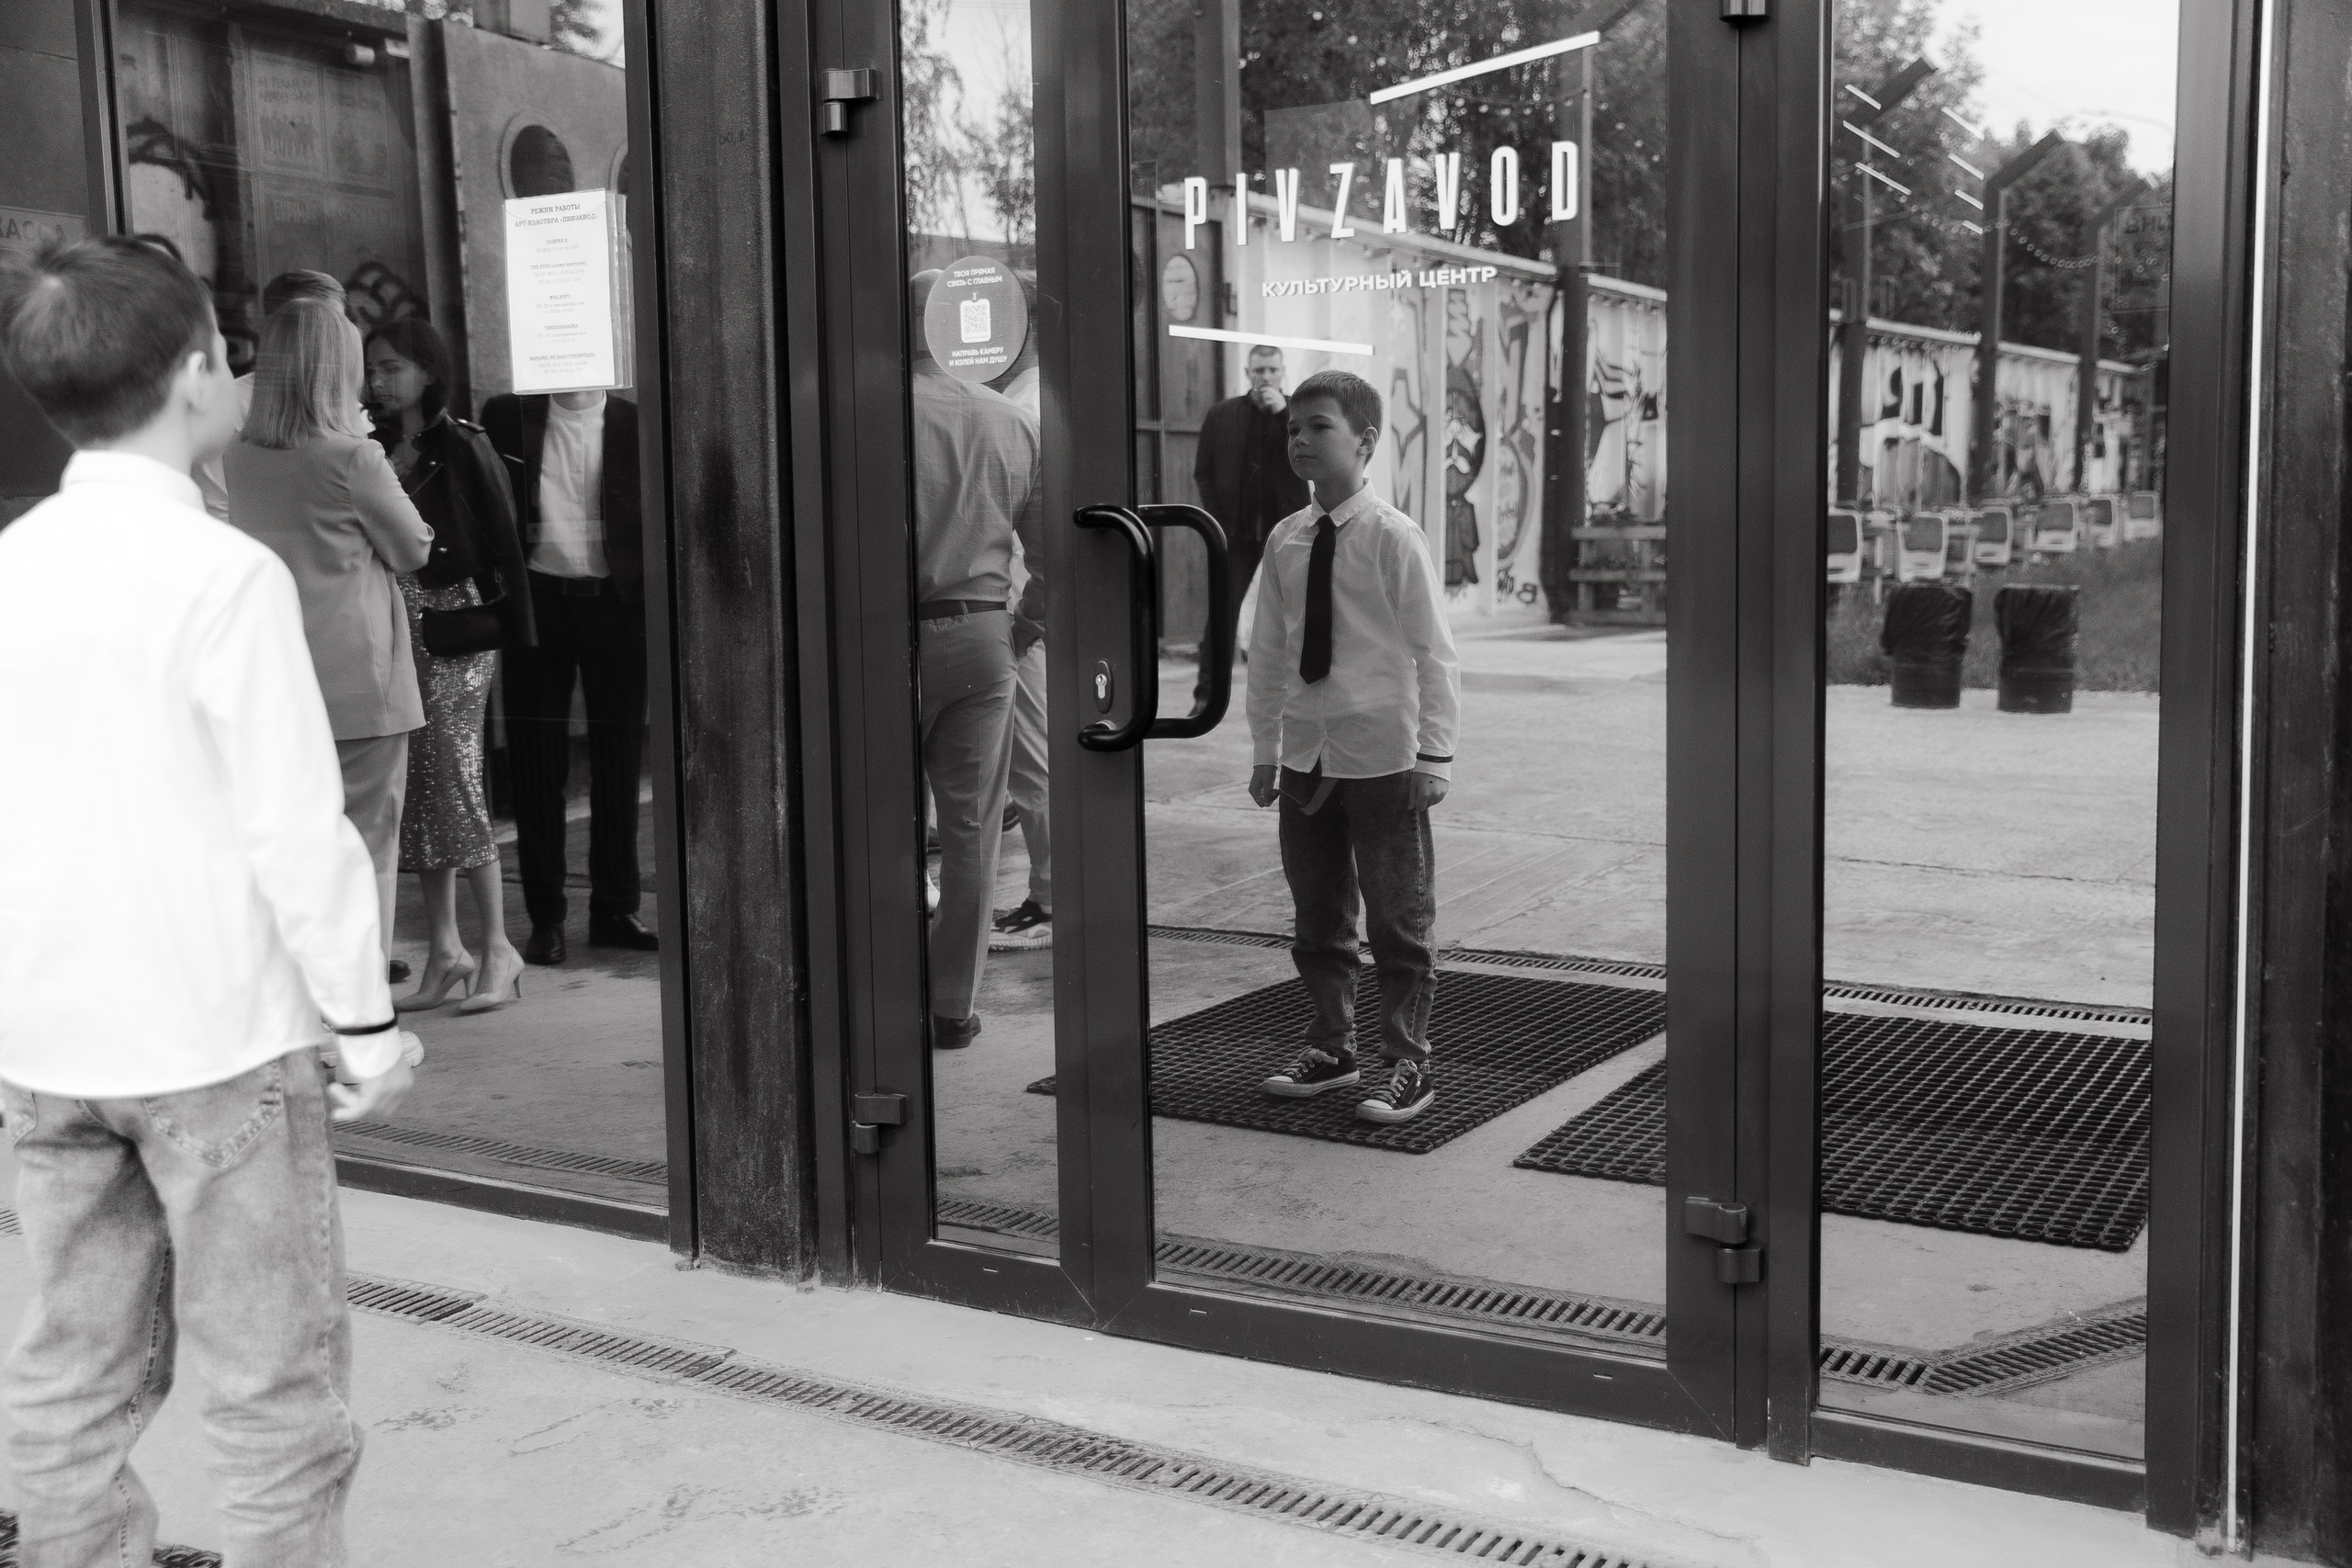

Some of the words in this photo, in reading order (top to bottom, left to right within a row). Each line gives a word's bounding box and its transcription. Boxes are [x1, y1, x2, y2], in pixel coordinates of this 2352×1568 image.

[1184, 141, 1578, 249] PIVZAVOD
[531, 207, 553, 215] РЕЖИМ
[555, 203, 581, 212] РАБОТЫ
[514, 217, 559, 227] АРТ-КЛАСТЕРА
[970, 267, 996, 276] ПРЯМАЯ
[947, 279, 967, 288] СВЯЗЬ
[973, 276, 1002, 285] ГЛАВНЫМ
[1261, 270, 1413, 299] КУЛЬТУРНЫЙ
[1419, 266, 1498, 290] ЦЕНТР
[952, 349, 979, 357] НАПРАВЬ
[980, 346, 1005, 355] КАМЕРУ
[955, 357, 975, 367] ИЗЛЕЙ
[975, 356, 989, 365] НАМ
[989, 355, 1008, 365] ДУШУ
